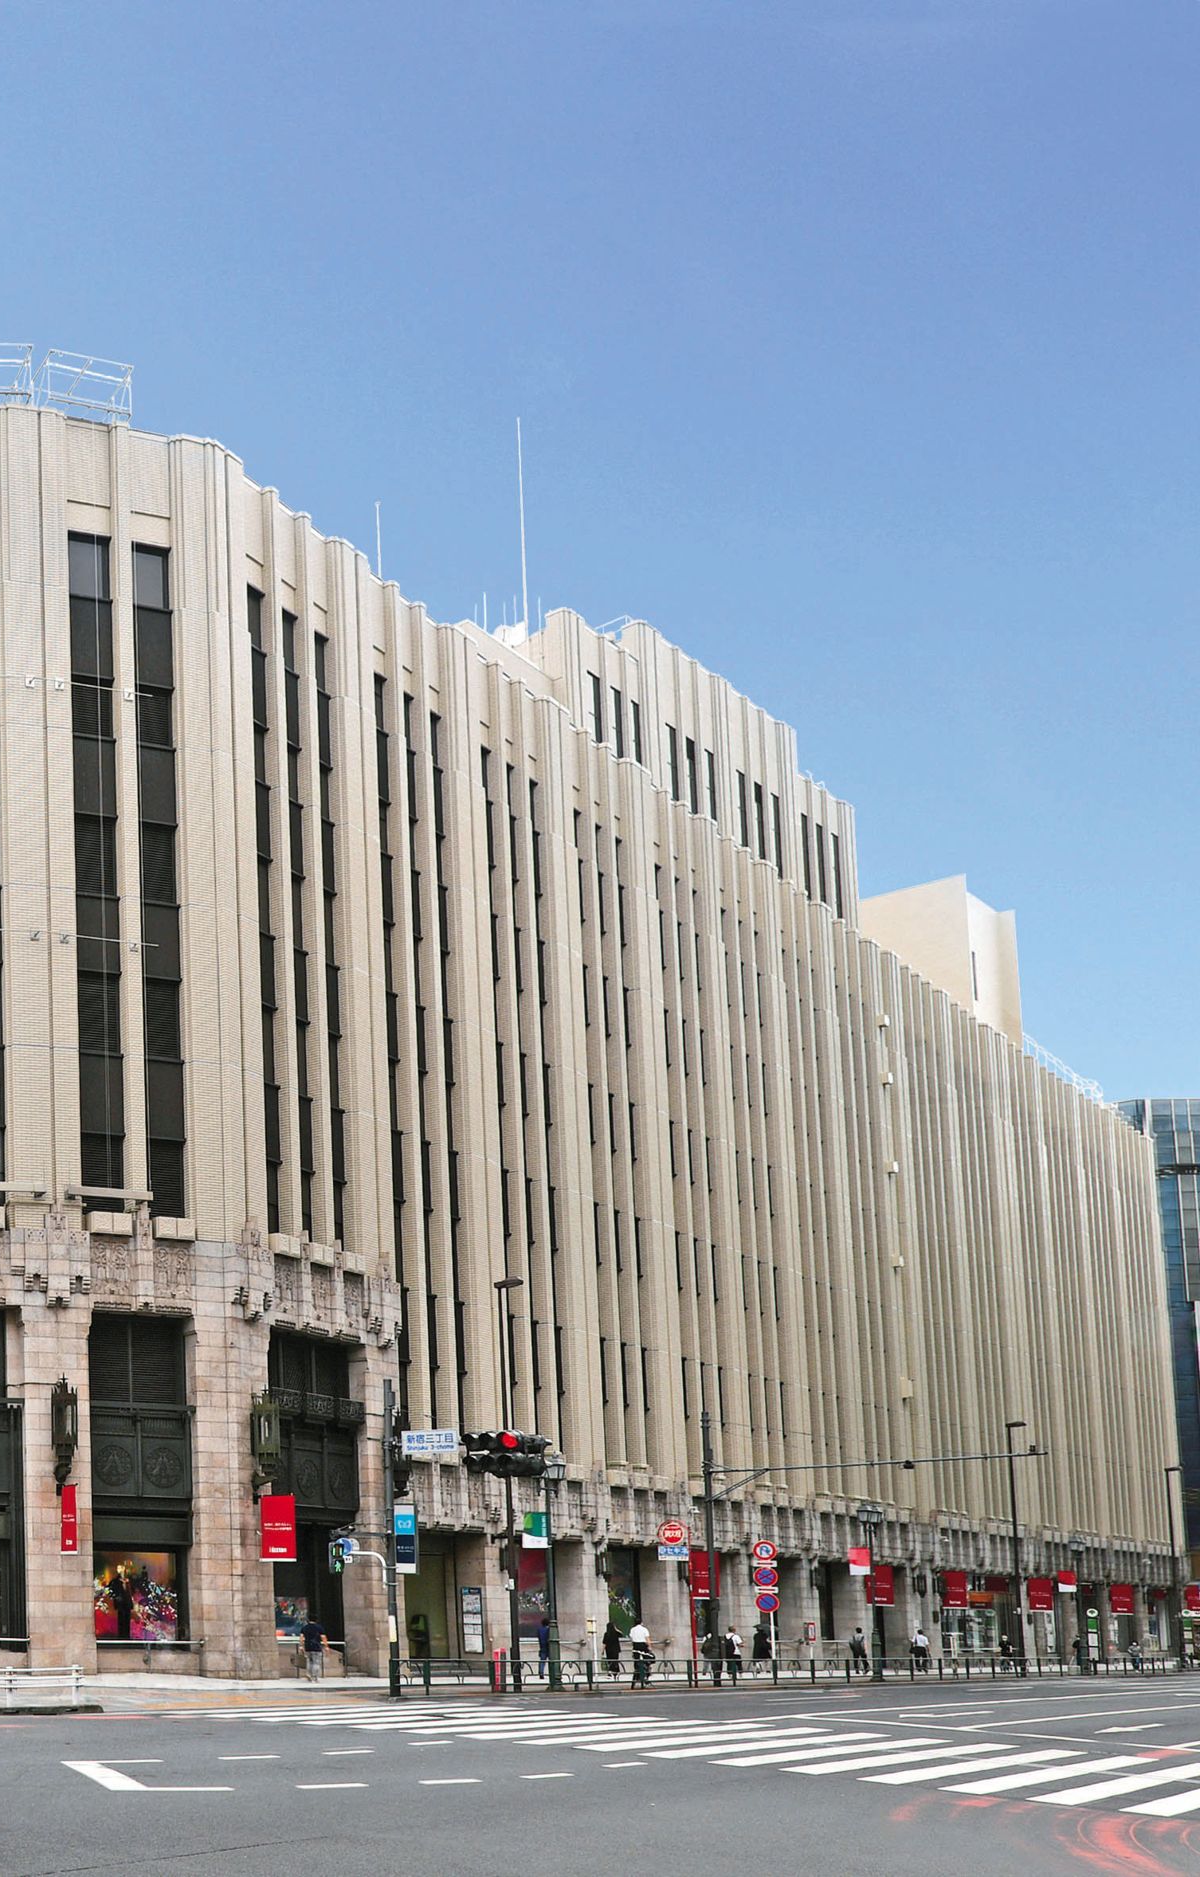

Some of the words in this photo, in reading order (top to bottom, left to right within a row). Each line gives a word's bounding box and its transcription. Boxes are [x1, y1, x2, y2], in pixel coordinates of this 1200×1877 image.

[406, 1433, 454, 1444] 新宿三丁目
